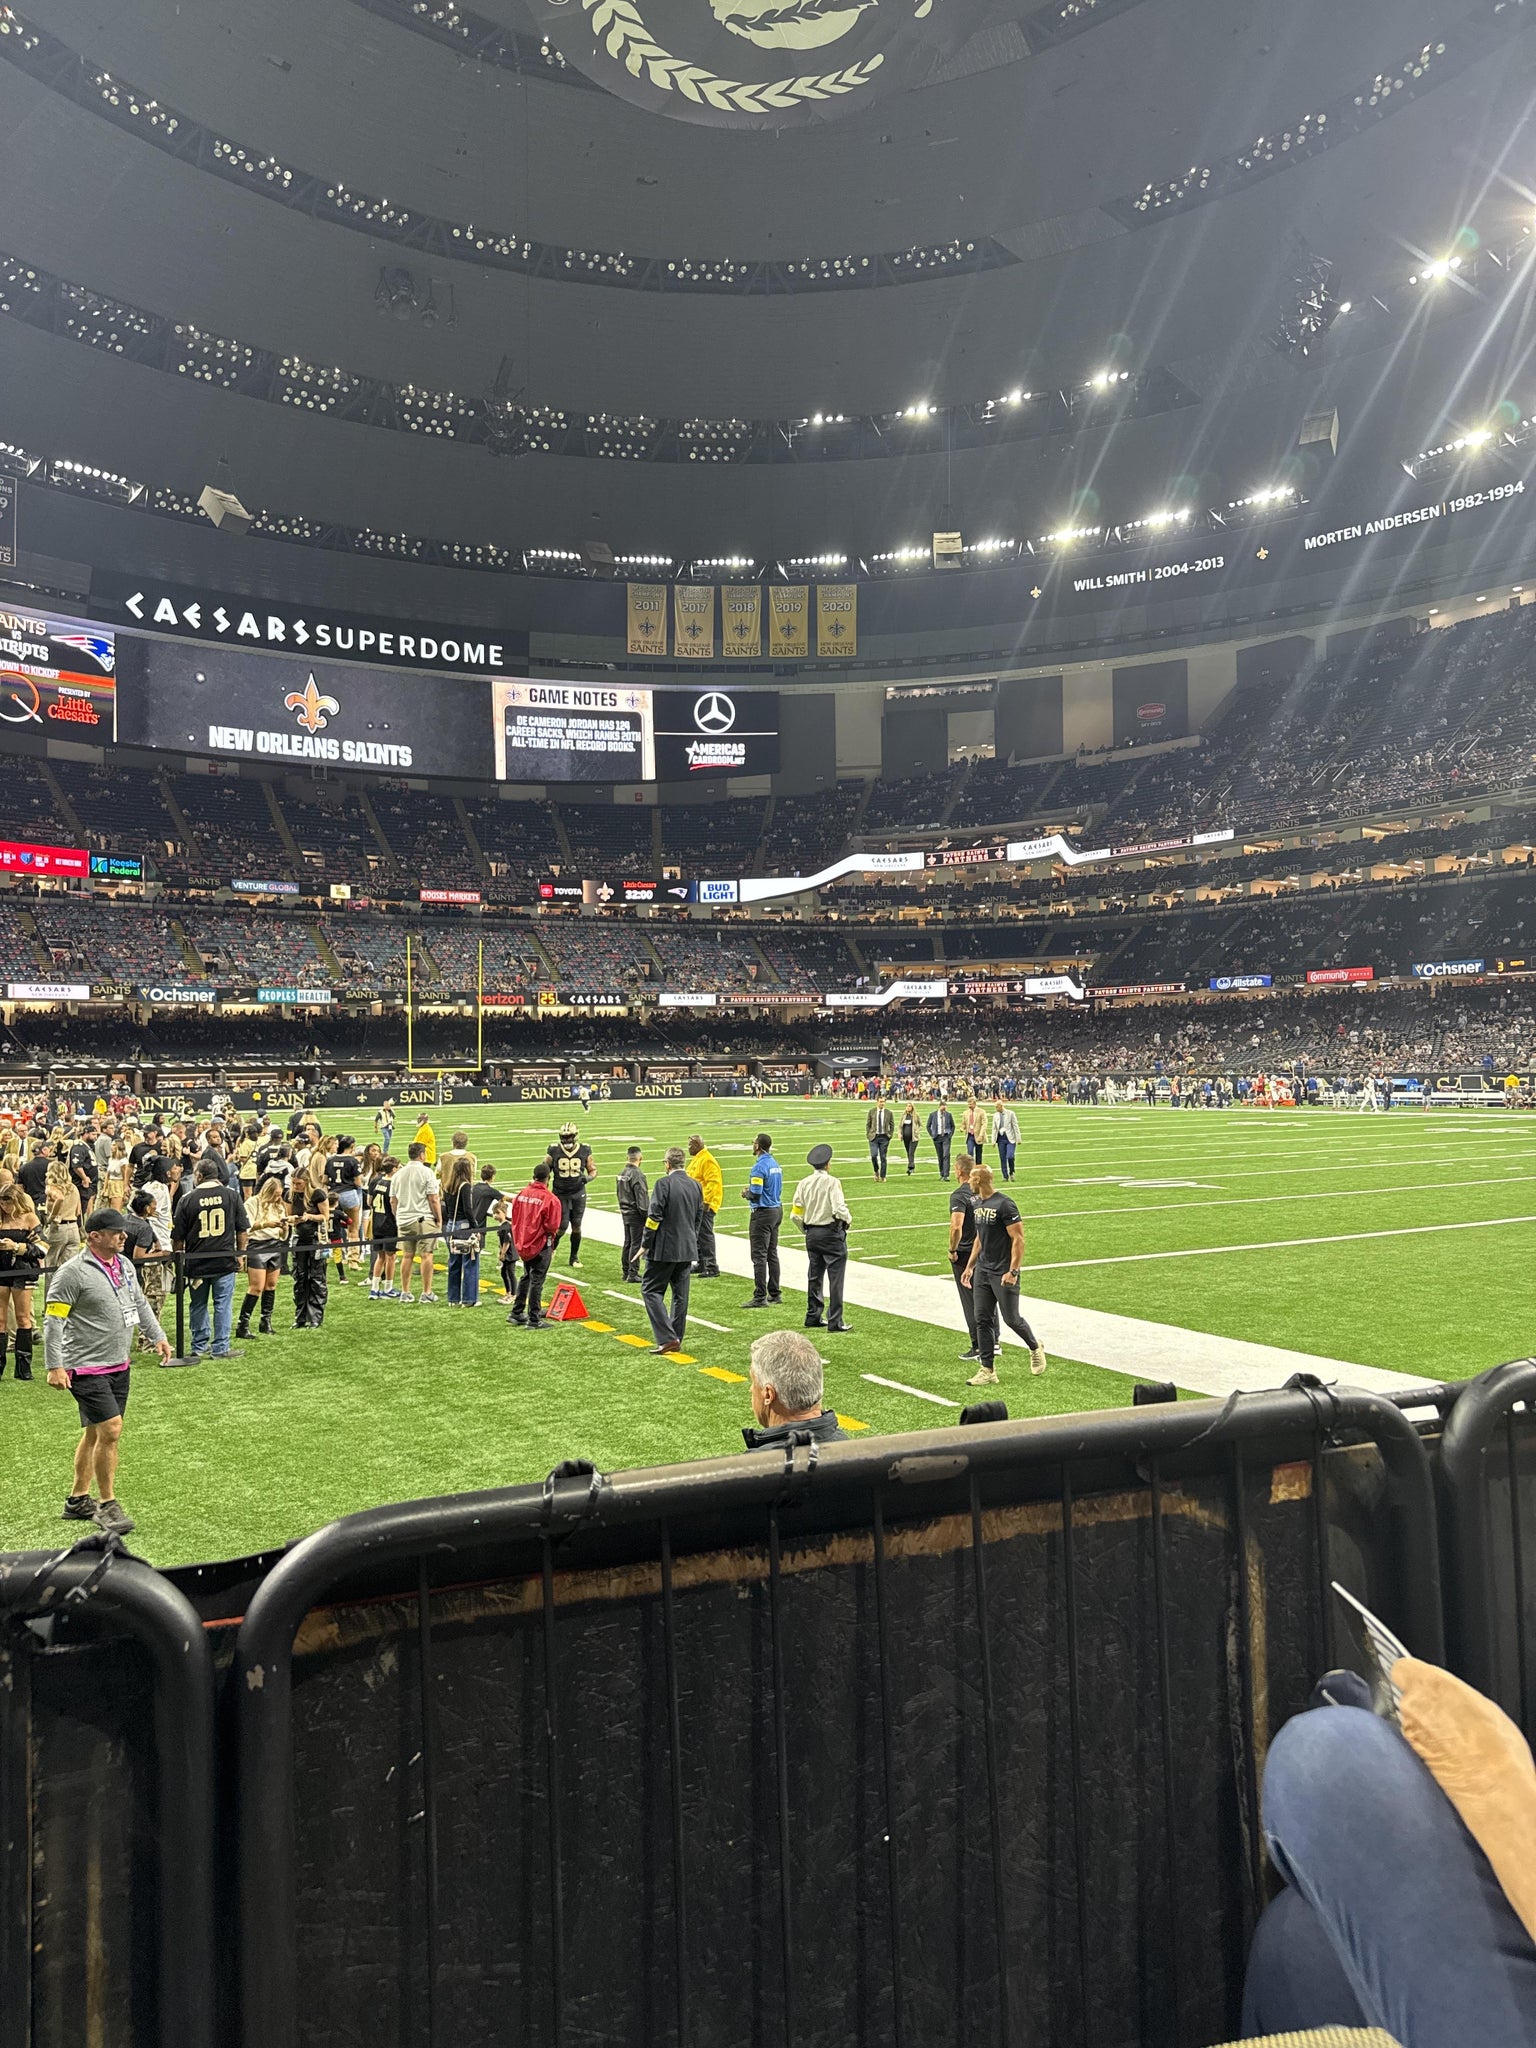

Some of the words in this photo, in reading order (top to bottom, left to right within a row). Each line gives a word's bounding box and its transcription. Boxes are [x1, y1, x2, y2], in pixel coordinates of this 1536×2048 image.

[1304, 526, 1362, 551] MORTEN
[1364, 504, 1441, 535] ANDERSEN
[1449, 481, 1526, 513] 1982-1994
[1073, 577, 1104, 592] WILL
[1105, 570, 1146, 588] SMITH
[1154, 556, 1225, 580] 2004-2013
[634, 601, 660, 611] 2011
[682, 603, 708, 613] 2017
[728, 602, 755, 612] 2018
[775, 603, 802, 612] 2019
[822, 602, 851, 612] 2020
[0, 613, 47, 636] AINTS
[125, 592, 311, 645] CAESARS
[315, 624, 504, 666] SUPERDOME
[0, 638, 49, 662] TRIOTS
[630, 644, 664, 654] SAINTS
[677, 646, 711, 656] SAINTS
[725, 646, 760, 656] SAINTS
[771, 646, 806, 655] SAINTS
[819, 646, 854, 655] SAINTS
[20, 663, 30, 675] TO
[31, 665, 60, 679] KICKOFF
[529, 688, 570, 706] GAME
[573, 690, 617, 707] NOTES
[57, 695, 94, 713] Little
[47, 704, 100, 725] Caesars
[516, 715, 528, 726] DE
[528, 716, 567, 729] CAMERON
[568, 718, 598, 730] JORDAN
[599, 719, 615, 731] HAS
[505, 725, 537, 737] CAREER
[537, 727, 565, 740] SACKS,
[565, 728, 593, 740] WHICH
[594, 730, 620, 741] RANKS
[621, 731, 642, 742] 20TH
[208, 725, 254, 752] NEW
[256, 730, 340, 761] ORLEANS
[342, 740, 413, 767] SAINTS
[511, 736, 549, 749] ALL-TIME
[549, 738, 560, 749] IN
[560, 739, 575, 750] NFL
[575, 740, 607, 752] RECORD
[685, 740, 746, 757] AMERICAS
[1487, 780, 1524, 793] SAINTS
[1409, 794, 1444, 807] SAINTS
[1337, 807, 1371, 819] SAINTS
[1269, 818, 1300, 830] SAINTS
[1472, 836, 1506, 847] SAINTS
[1402, 846, 1434, 857] SAINTS
[109, 858, 141, 868] Keesler
[943, 854, 989, 864] PARTNERS
[1336, 855, 1366, 866] SAINTS
[109, 866, 141, 876] Federal
[1273, 863, 1301, 874] SAINTS
[188, 876, 221, 886] SAINTS
[1212, 872, 1240, 881] SAINTS
[232, 881, 268, 890] VENTURE
[268, 883, 299, 892] GLOBAL
[707, 883, 731, 893] BUD
[1155, 879, 1182, 889] SAINTS
[358, 886, 389, 896] SAINTS
[554, 888, 583, 896] TOYOTA
[625, 889, 654, 900] 32:00
[702, 891, 735, 900] LIGHT
[1040, 891, 1067, 899] SAINTS
[1098, 886, 1125, 894] SAINTS
[420, 891, 447, 900] ROUSES
[448, 892, 480, 902] MARKETS
[489, 893, 517, 902] SAINTS
[980, 895, 1008, 903] SAINTS
[1422, 961, 1482, 977] Ochsner
[1274, 974, 1305, 983] SAINTS
[1310, 970, 1350, 982] Community
[28, 985, 72, 993] CAESARS
[93, 985, 131, 995] SAINTS
[150, 987, 215, 1002] Ochsner
[345, 990, 379, 999] SAINTS
[259, 990, 296, 1001] PEOPLES
[299, 990, 330, 1001] HEALTH
[418, 991, 450, 1000] SAINTS
[476, 992, 524, 1005] verizon
[541, 993, 556, 1004] 25
[569, 994, 622, 1005] CAESARS
[628, 993, 657, 1001] SAINTS
[520, 1086, 571, 1100] SAINTS
[635, 1084, 683, 1097] SAINTS
[743, 1082, 789, 1095] SNTS
[266, 1092, 326, 1107] SAIN
[399, 1089, 453, 1103] SAINS
[136, 1095, 185, 1111] AINTS
[335, 1168, 342, 1183] 1
[199, 1196, 223, 1207] COOKS
[372, 1193, 386, 1214] 41
[198, 1208, 225, 1238] 10
